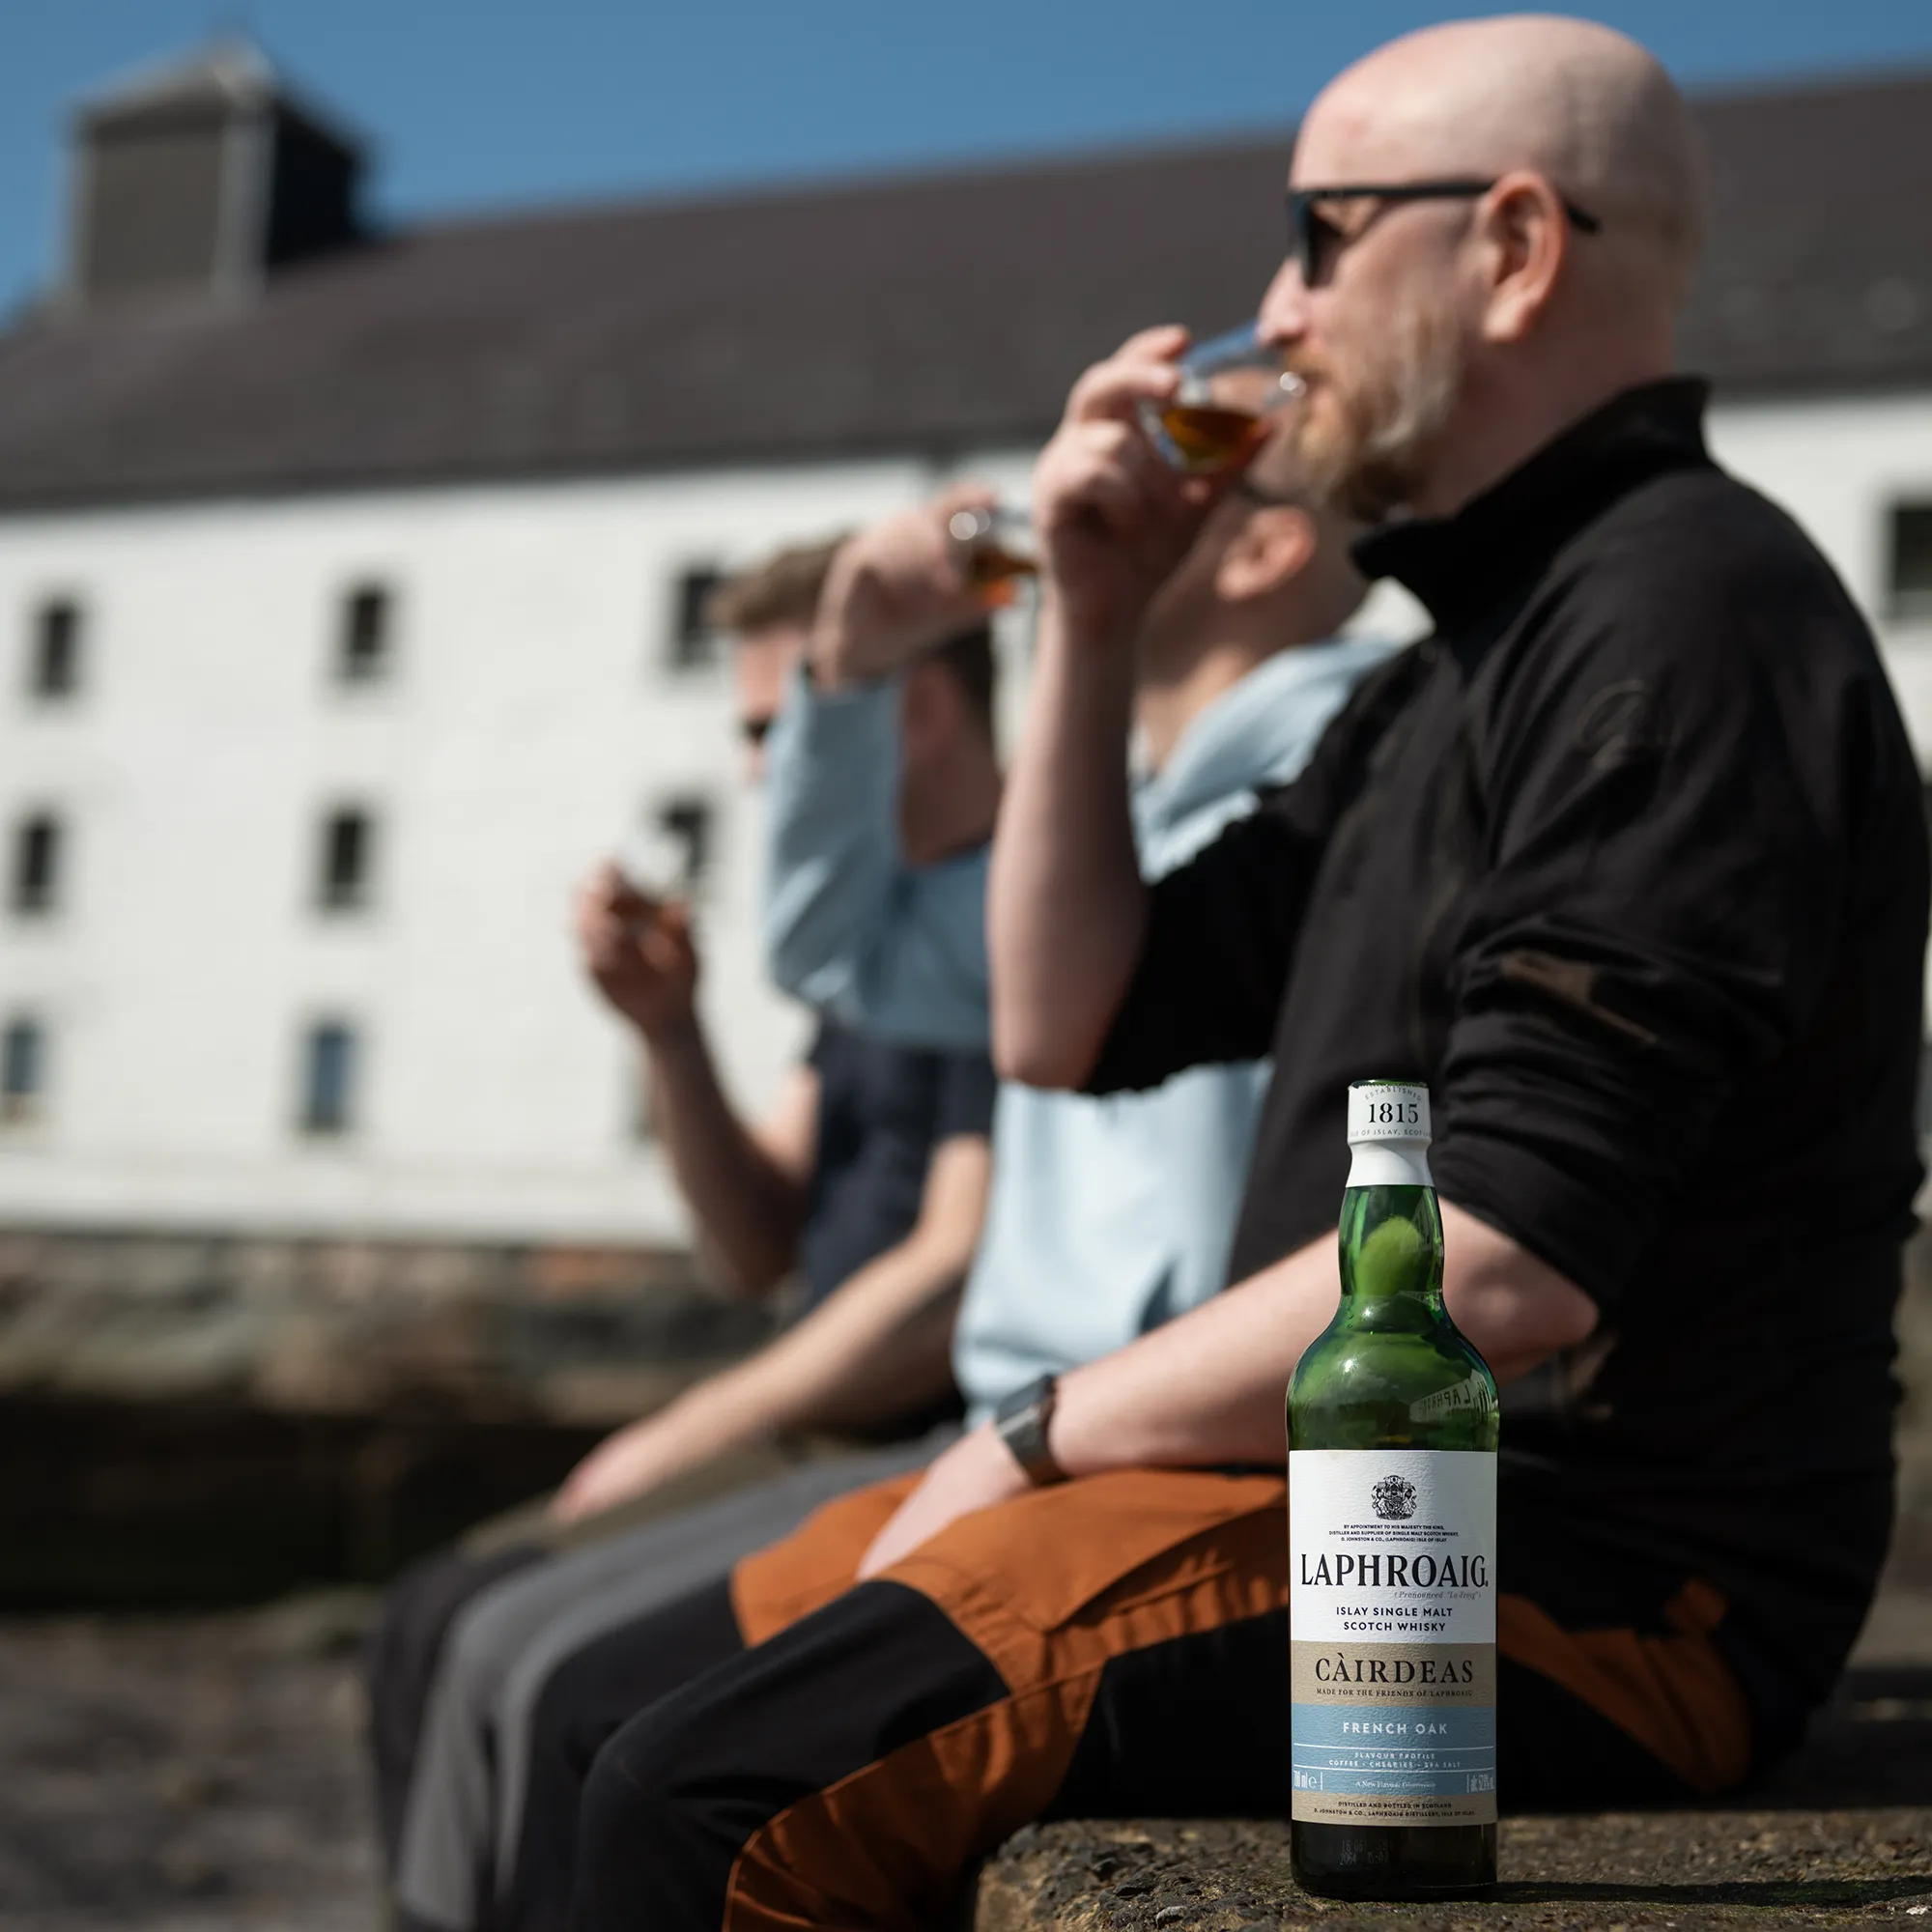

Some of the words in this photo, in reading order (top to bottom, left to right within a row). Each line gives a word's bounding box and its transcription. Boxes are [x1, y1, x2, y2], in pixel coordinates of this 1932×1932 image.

[1365, 1086, 1422, 1101] ESTABLISHED
[1369, 1102, 1418, 1123] 1815
[1336, 1606, 1369, 1616] ISLAY
[1373, 1606, 1418, 1617] SINGLE
[1423, 1607, 1453, 1617] MALT
[1344, 1621, 1392, 1632] SCOTCH
[1397, 1622, 1446, 1632] WHISKY
[1315, 1652, 1473, 1684] CÀIRDEAS
[1343, 1722, 1406, 1734] FRENCH
[1415, 1723, 1448, 1735] OAK
